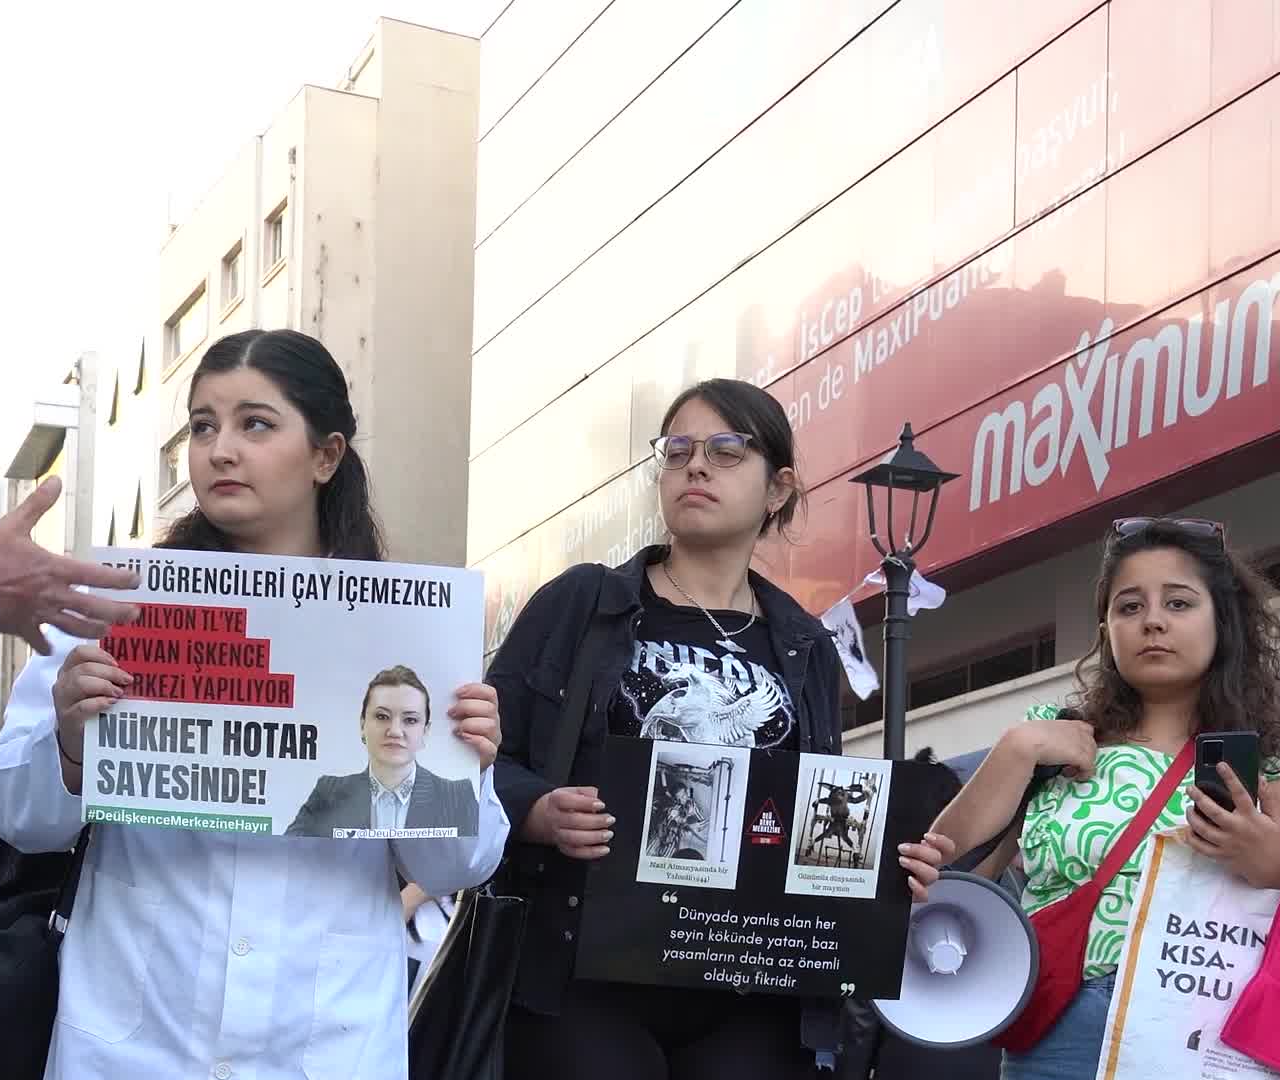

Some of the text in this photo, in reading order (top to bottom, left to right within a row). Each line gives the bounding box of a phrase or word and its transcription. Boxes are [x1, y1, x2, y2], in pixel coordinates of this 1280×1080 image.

[148, 559, 286, 599] ÖĞRENCİLERİ
[292, 572, 333, 609] ÇAY
[337, 570, 452, 612] İÇEMEZKEN
[201, 609, 244, 634] TL'YE
[103, 636, 266, 673] HAYVAN İŞKENCE
[191, 675, 290, 707] YAPILIYOR
[97, 711, 320, 761] NÜKHET HOTAR
[96, 758, 268, 806] SAYESİNDE!
[678, 906, 739, 925] Dünyada
[783, 914, 812, 930] olan
[815, 916, 837, 930] her
[707, 928, 763, 945] kökünde
[766, 935, 808, 951] yatan,
[811, 936, 839, 951] bazı
[738, 951, 774, 967] daha
[778, 957, 795, 968] az
[797, 956, 841, 971] önemli
[1160, 942, 1235, 971] KISA-
[703, 968, 797, 988] olduğu fikridir
[1156, 968, 1233, 1001] YOLU
